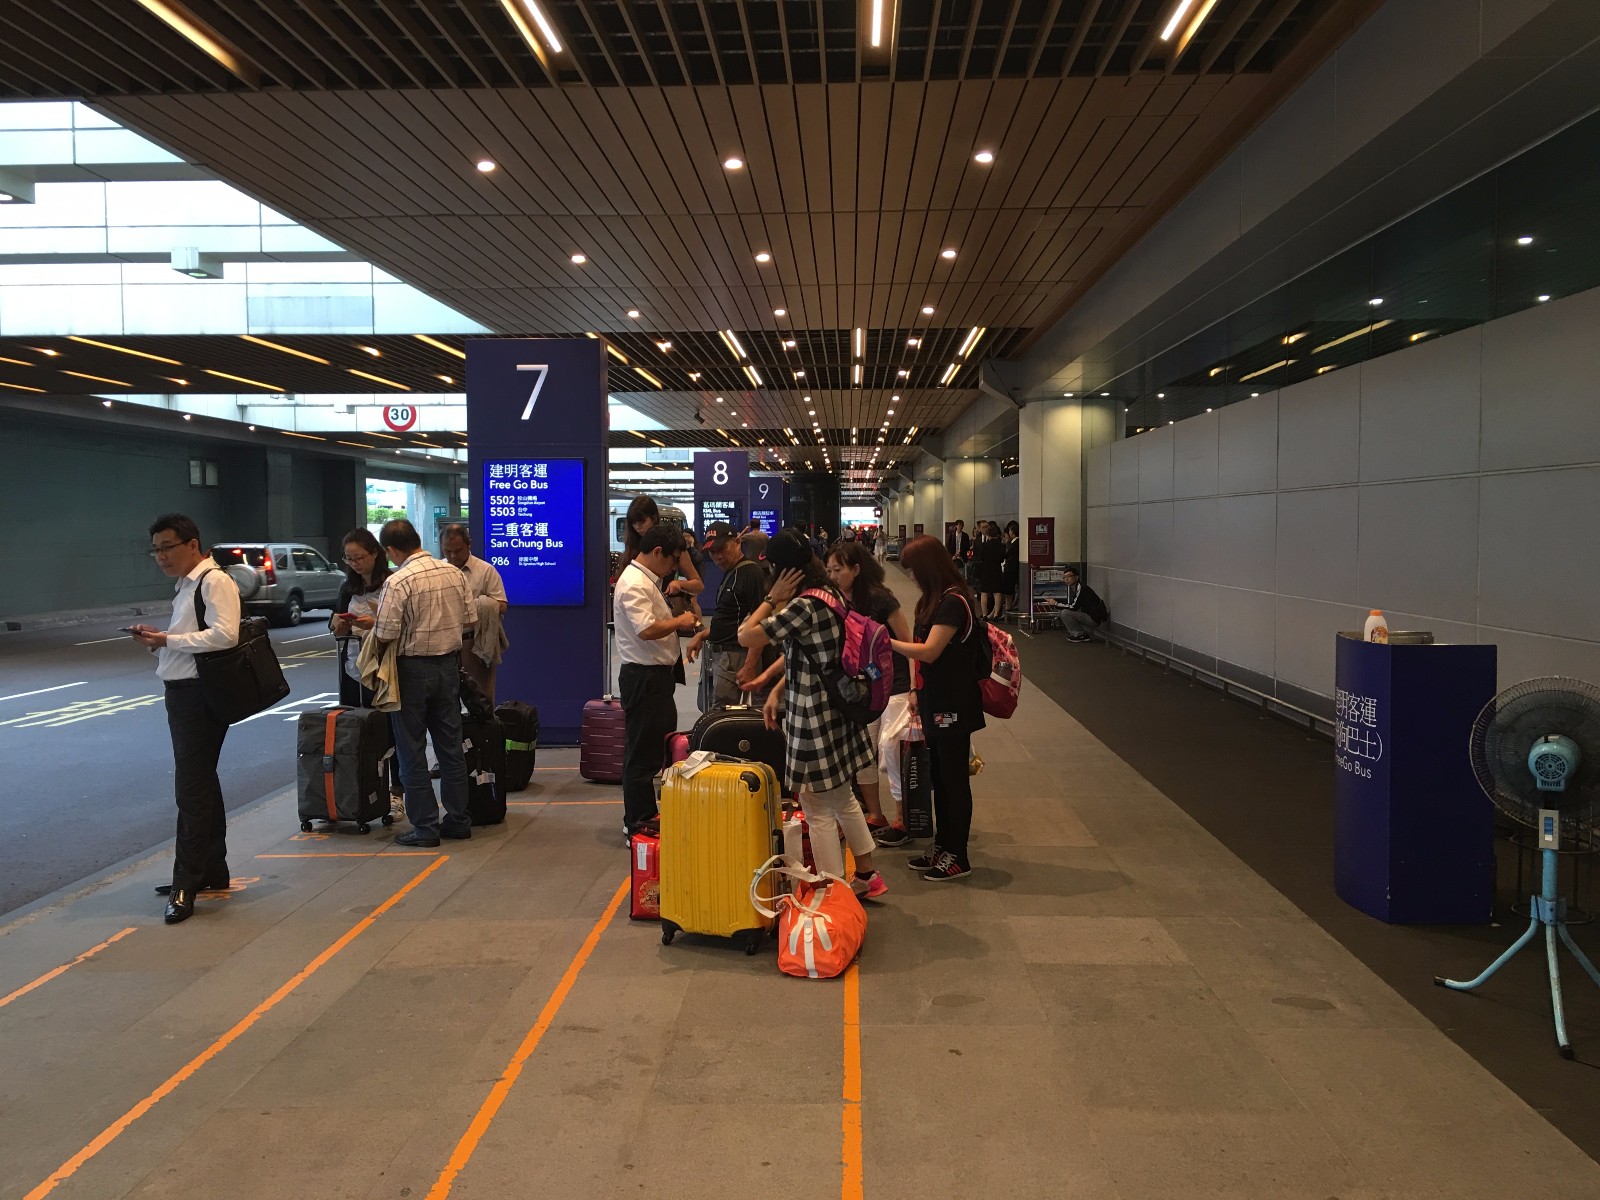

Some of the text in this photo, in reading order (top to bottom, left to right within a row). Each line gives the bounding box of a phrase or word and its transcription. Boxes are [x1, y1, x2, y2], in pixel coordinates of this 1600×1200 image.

[516, 364, 549, 420] 7
[391, 408, 409, 420] 30
[489, 463, 548, 478] 建明客運
[713, 460, 729, 485] 8
[489, 480, 548, 489] Free Go Bus
[758, 483, 769, 500] 9
[490, 495, 515, 505] 5502
[490, 507, 515, 516] 5503
[490, 522, 549, 537] 三重客運
[490, 538, 564, 550] San Chung Bus
[491, 556, 510, 566] 986
[910, 756, 919, 790] everrich
[1354, 761, 1372, 779] Bus
